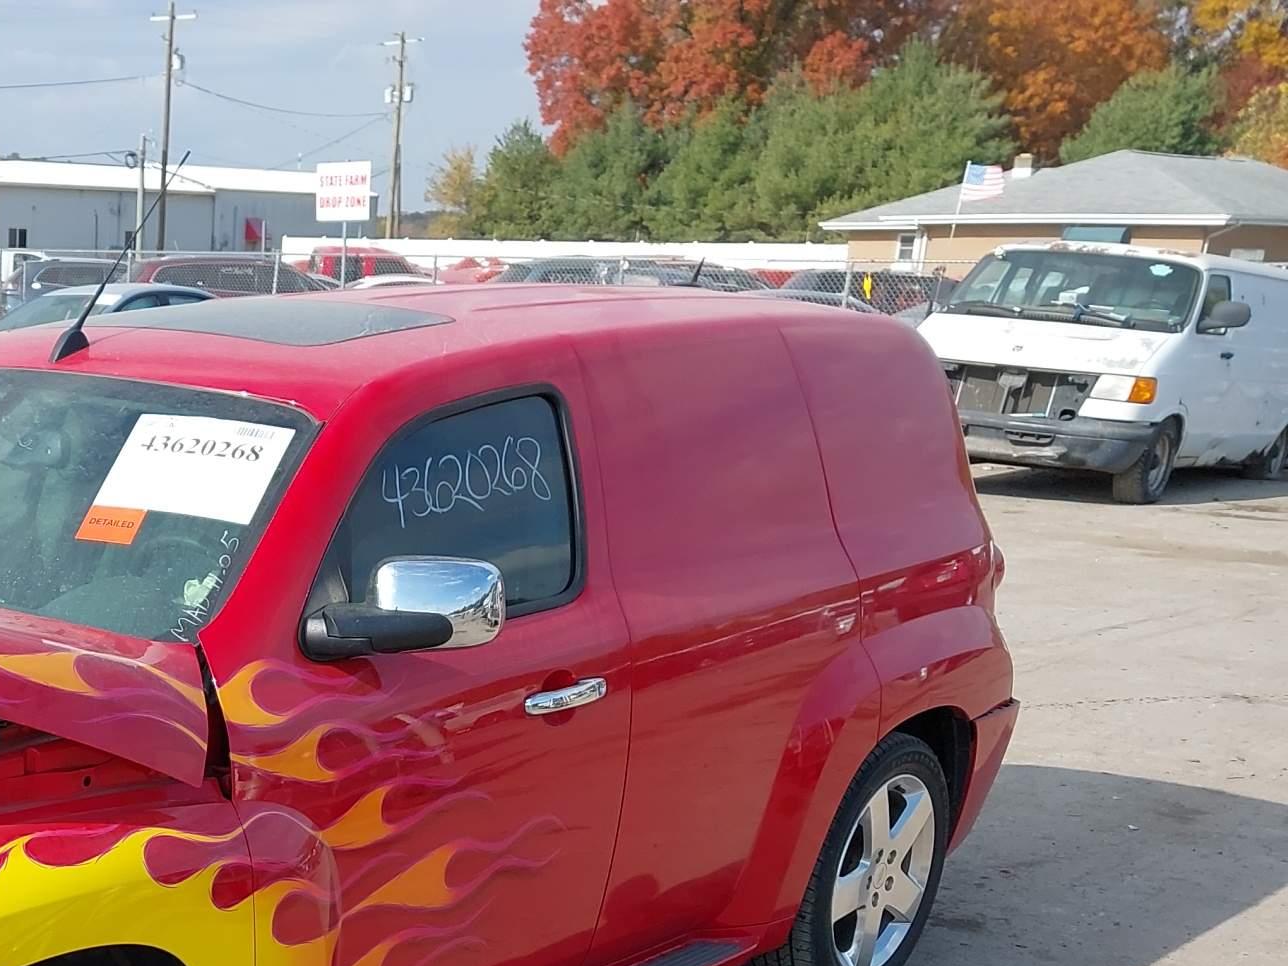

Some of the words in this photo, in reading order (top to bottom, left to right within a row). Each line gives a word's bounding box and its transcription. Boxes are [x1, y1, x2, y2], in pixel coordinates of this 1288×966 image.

[319, 175, 342, 187] STATE
[345, 174, 368, 186] FARM
[319, 196, 342, 208] DROP
[345, 195, 367, 208] ZONE
[141, 435, 264, 462] 43620268
[382, 436, 551, 528] 43620268
[88, 517, 135, 529] DETAILED
